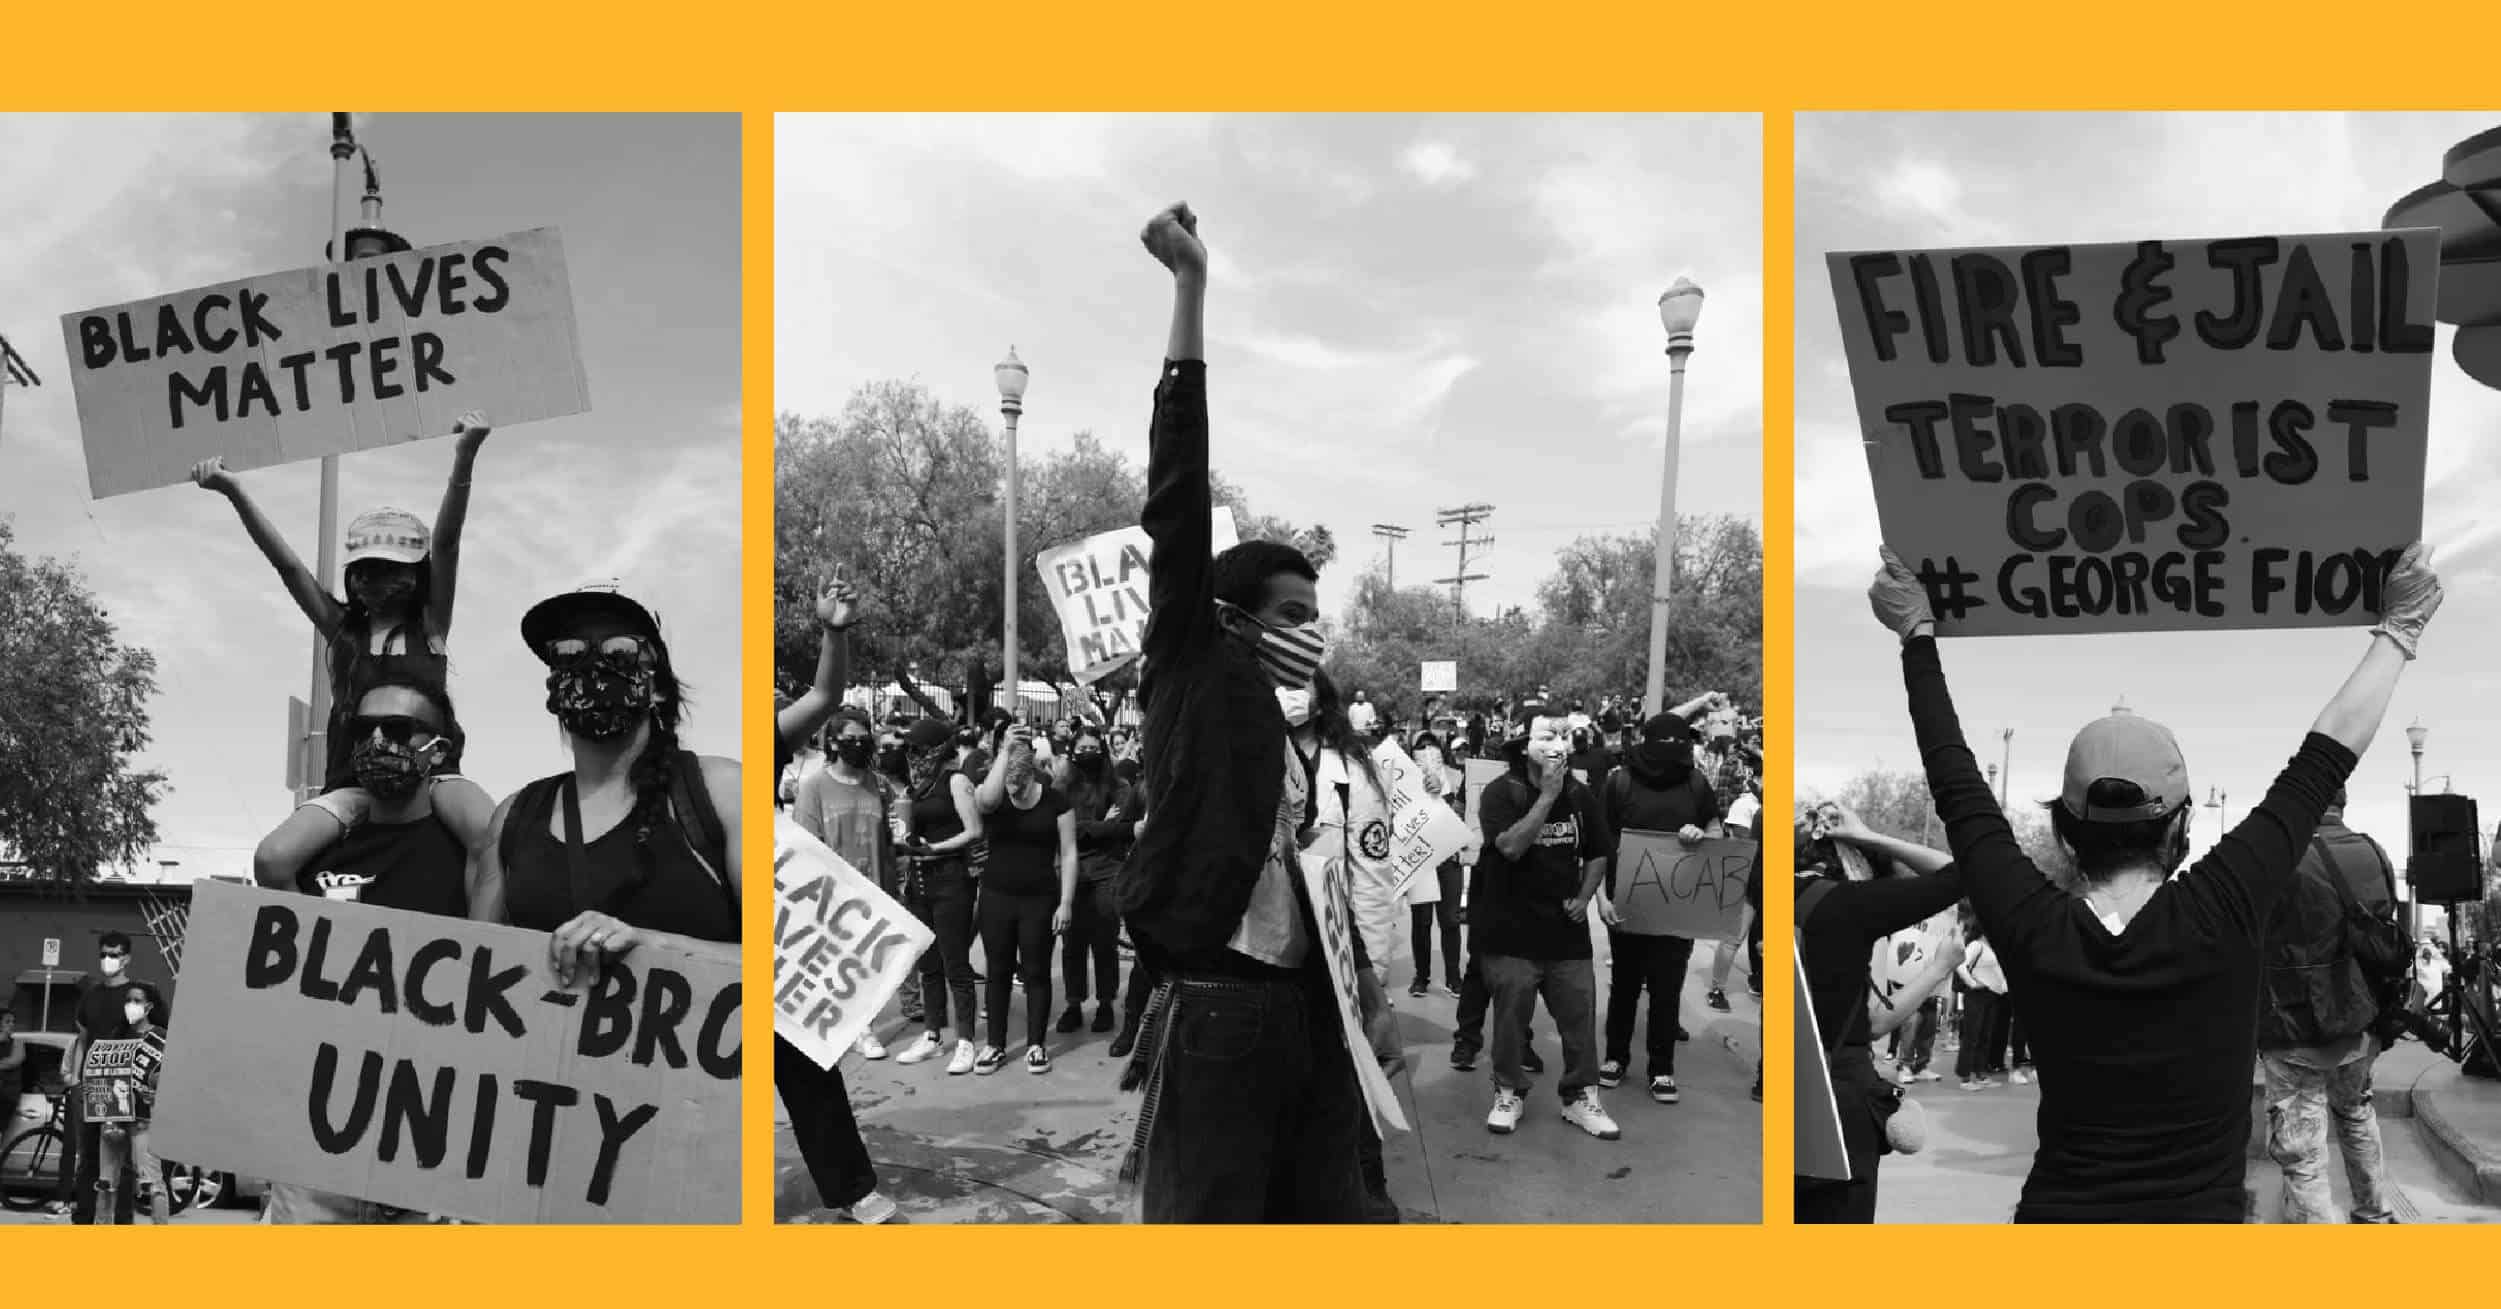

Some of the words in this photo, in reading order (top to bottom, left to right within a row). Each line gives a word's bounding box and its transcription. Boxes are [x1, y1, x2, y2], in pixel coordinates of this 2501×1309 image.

[80, 288, 282, 369] BLACK
[327, 246, 509, 328] LIVES
[1849, 245, 2084, 368] FIRE
[2113, 240, 2181, 366] &
[2194, 236, 2434, 354] JAIL
[169, 333, 455, 428] MATTER
[1885, 393, 2399, 484] TERRORIST
[1624, 847, 1752, 912] ACAB
[89, 1051, 131, 1066] STOP
[308, 1042, 659, 1206] UNITY
